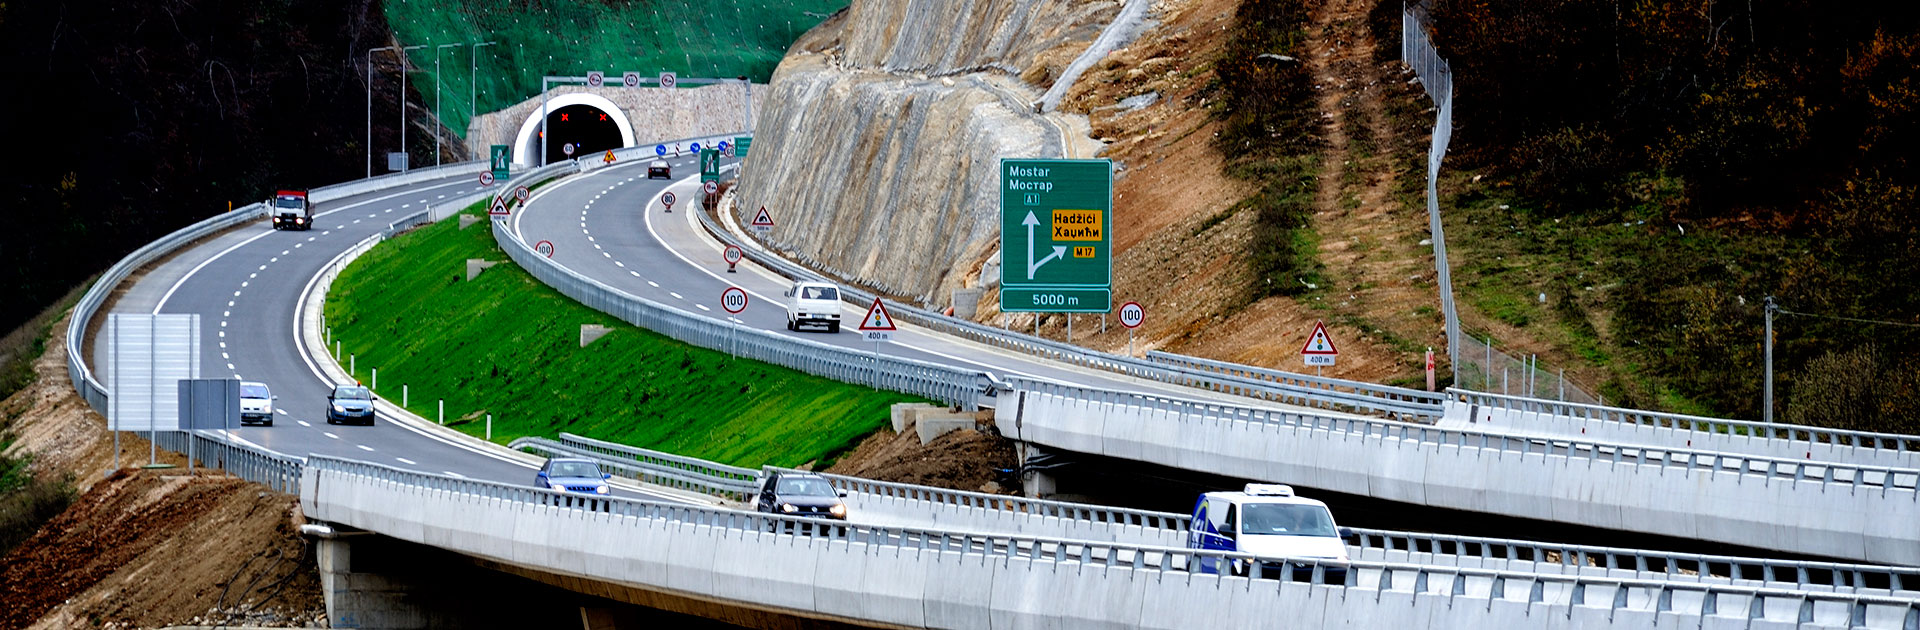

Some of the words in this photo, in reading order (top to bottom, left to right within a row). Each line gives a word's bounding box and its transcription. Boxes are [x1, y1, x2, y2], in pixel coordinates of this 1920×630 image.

[1009, 165, 1050, 177] Mostar
[1009, 179, 1053, 193] Мостар
[517, 189, 527, 197] 80
[664, 195, 673, 203] 80
[1054, 213, 1096, 224] Hadžići
[1054, 226, 1099, 239] Хаџићи
[538, 246, 551, 254] 100
[727, 250, 739, 259] 100
[726, 294, 743, 306] 100
[1032, 294, 1065, 305] 5000
[1068, 296, 1079, 305] m
[1123, 309, 1141, 321] 100
[868, 332, 881, 340] 400
[1310, 356, 1322, 364] 400
